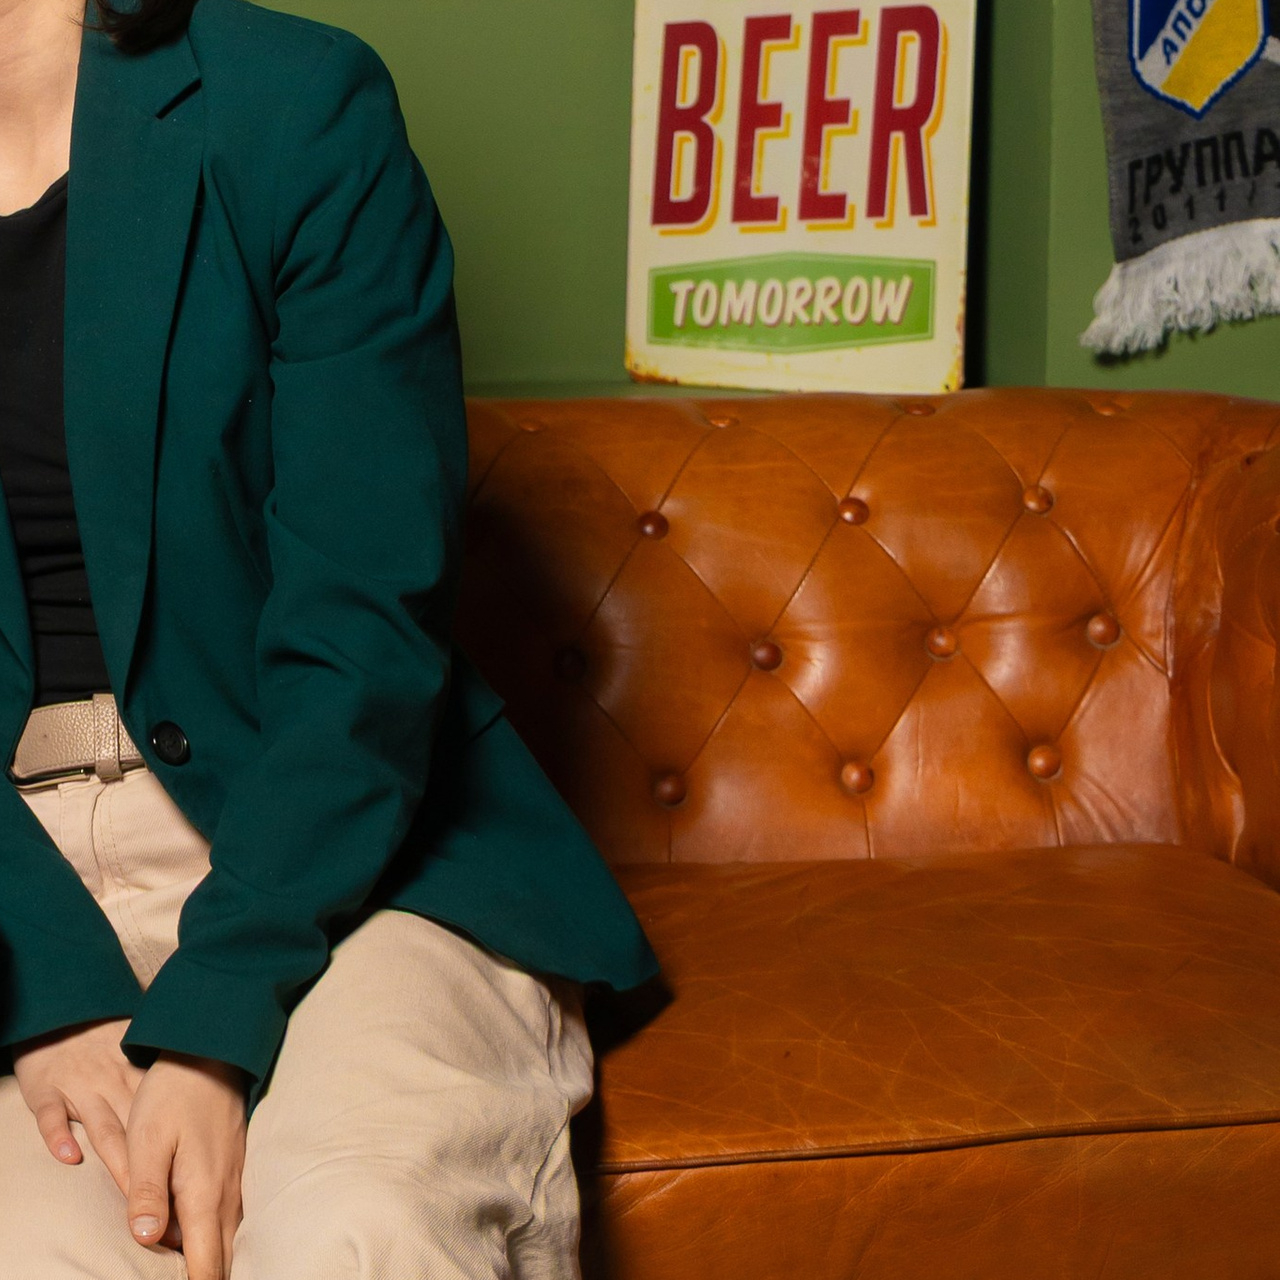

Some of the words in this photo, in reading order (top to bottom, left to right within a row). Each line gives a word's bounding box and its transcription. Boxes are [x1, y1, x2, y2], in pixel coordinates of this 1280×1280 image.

[650, 5, 949, 236] BEER
[1128, 128, 1280, 214] ГРУППА
[669, 275, 914, 328] TOMORROW
